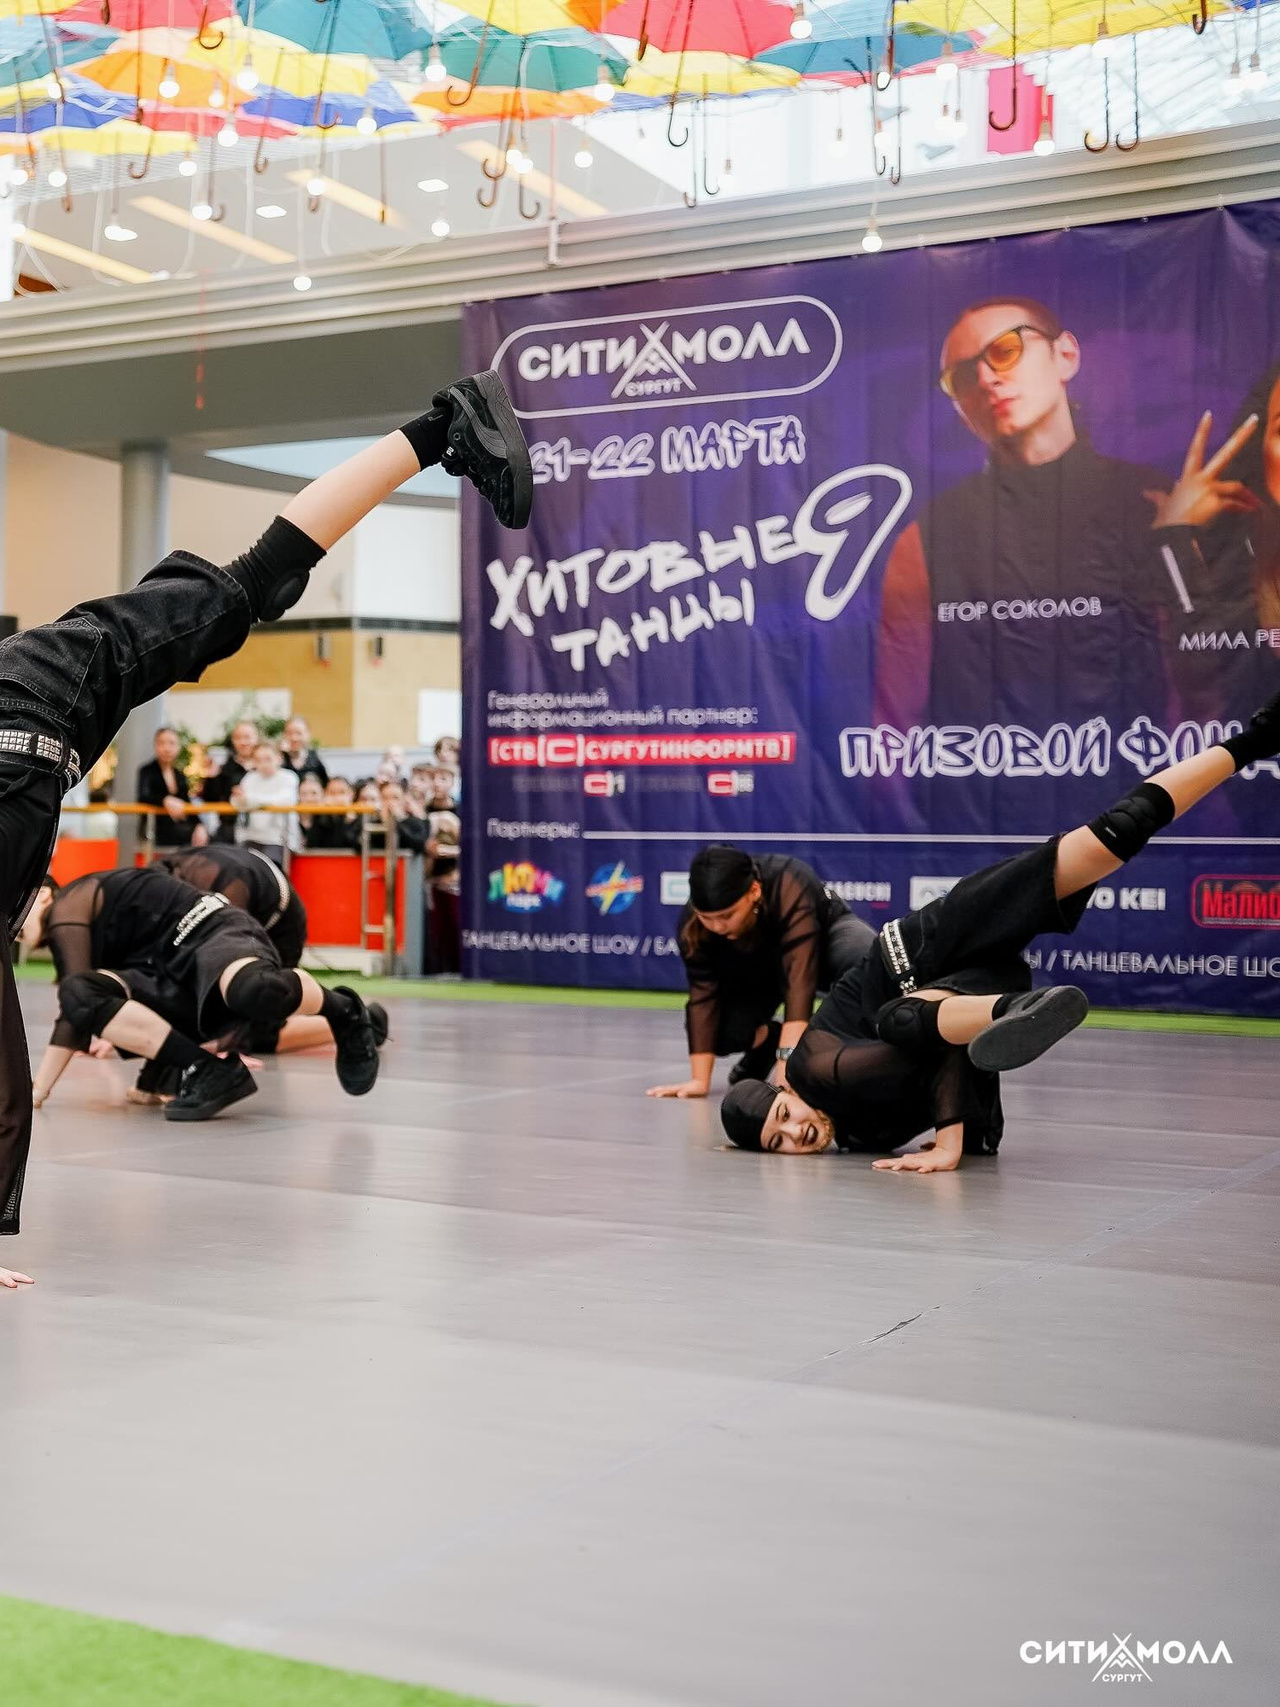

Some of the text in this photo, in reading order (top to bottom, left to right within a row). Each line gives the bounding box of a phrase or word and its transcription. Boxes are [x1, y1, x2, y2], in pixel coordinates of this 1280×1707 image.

[518, 317, 811, 382] СИТИ МОЛЛ
[530, 414, 807, 485] 21-22 МАРТА
[485, 514, 802, 637] ХИТОВЫЕ
[551, 577, 756, 672] ТАНЦЫ
[937, 596, 1103, 622] ЕГОР СОКОЛОВ
[1177, 630, 1250, 651] МИЛА
[839, 716, 1112, 778] ПРИЗОВОЙ
[1062, 949, 1238, 978] ТАНЦЕВАЛЬНОЕ
